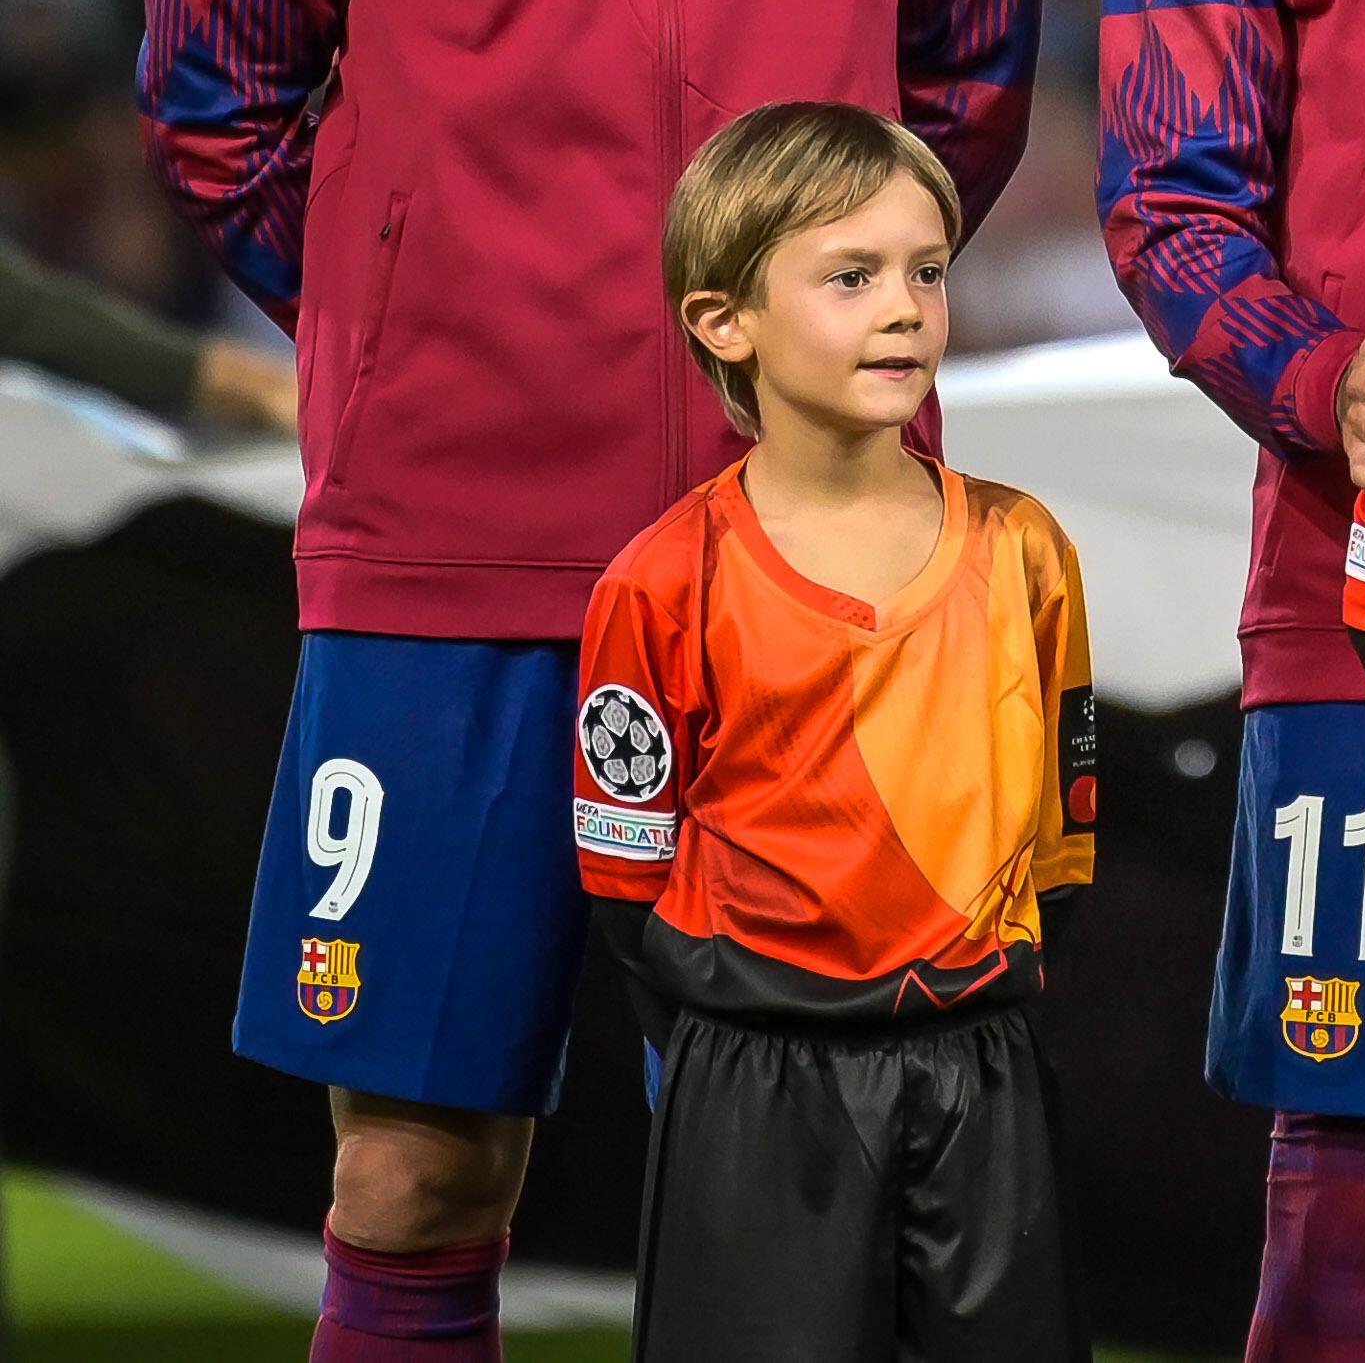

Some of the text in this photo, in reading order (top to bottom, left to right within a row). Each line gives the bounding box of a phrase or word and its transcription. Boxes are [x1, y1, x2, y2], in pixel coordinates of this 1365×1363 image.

[576, 802, 600, 818] UEFA
[307, 758, 385, 921] 9
[312, 973, 339, 985] FCB
[1306, 1012, 1336, 1023] FCB
